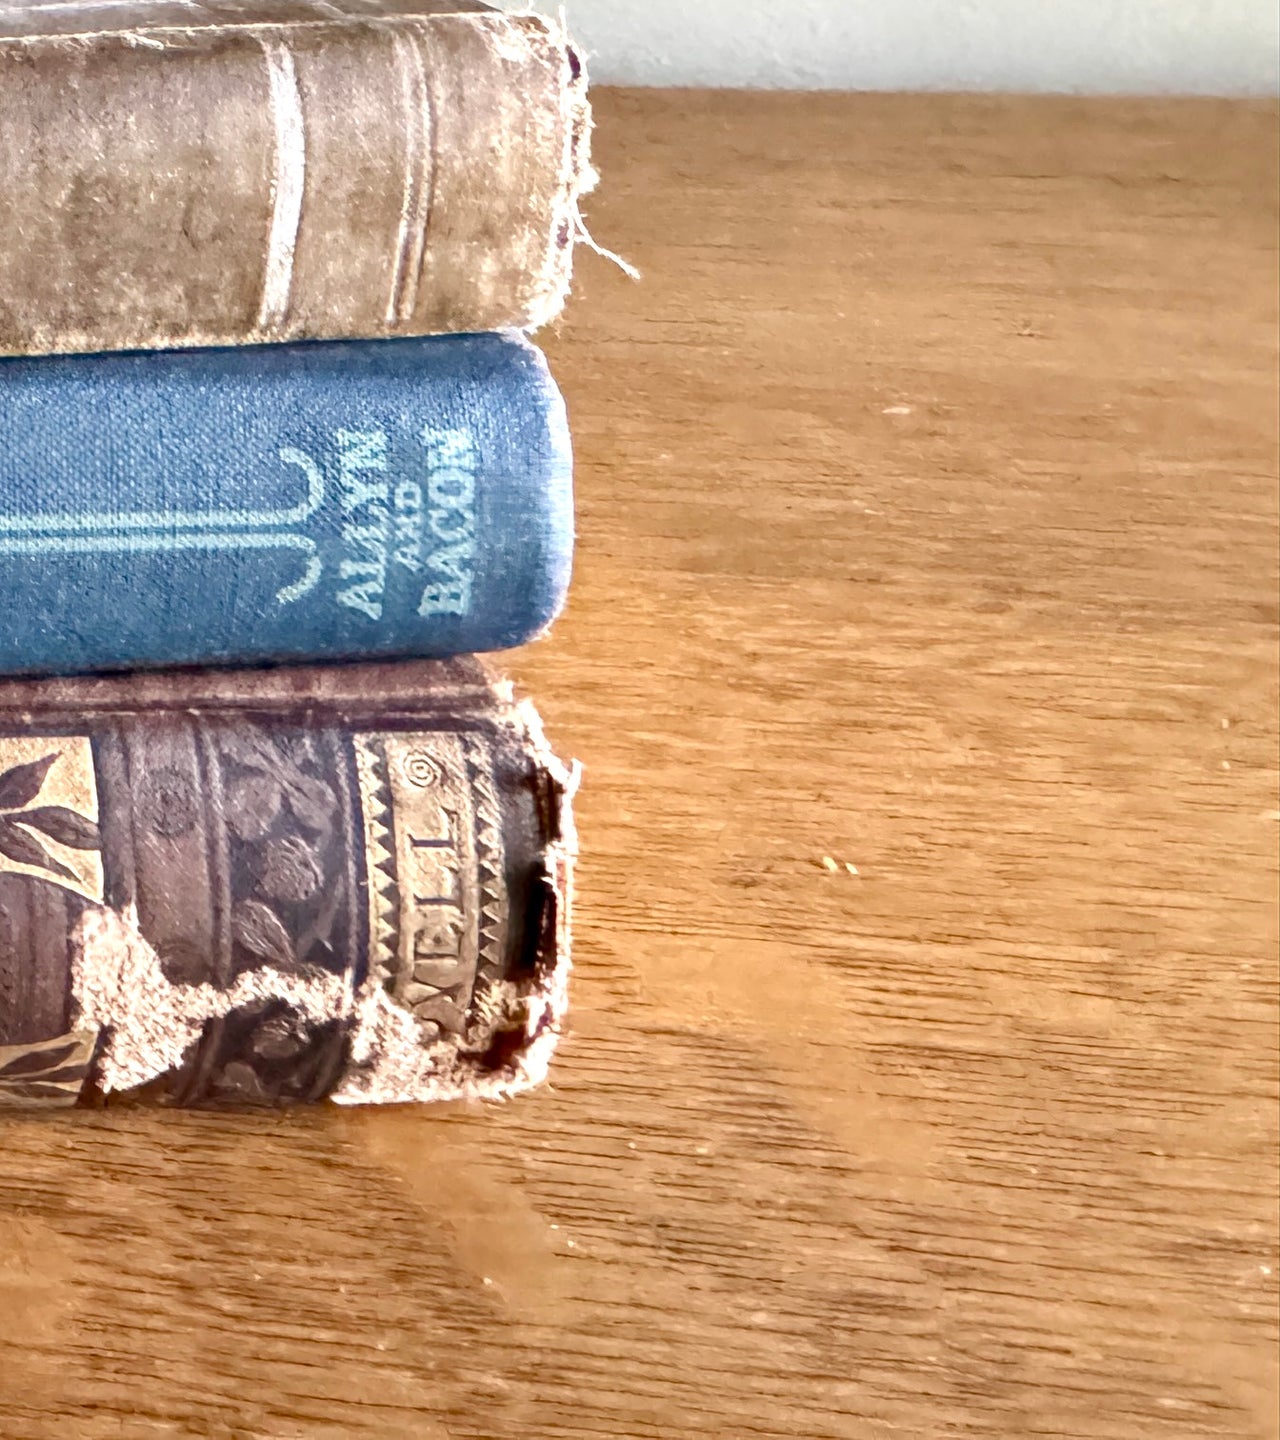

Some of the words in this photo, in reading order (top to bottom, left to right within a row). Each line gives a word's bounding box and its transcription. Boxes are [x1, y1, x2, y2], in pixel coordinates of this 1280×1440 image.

[336, 426, 389, 621] ALLYN
[392, 479, 425, 573] AND
[416, 424, 476, 618] BACON
